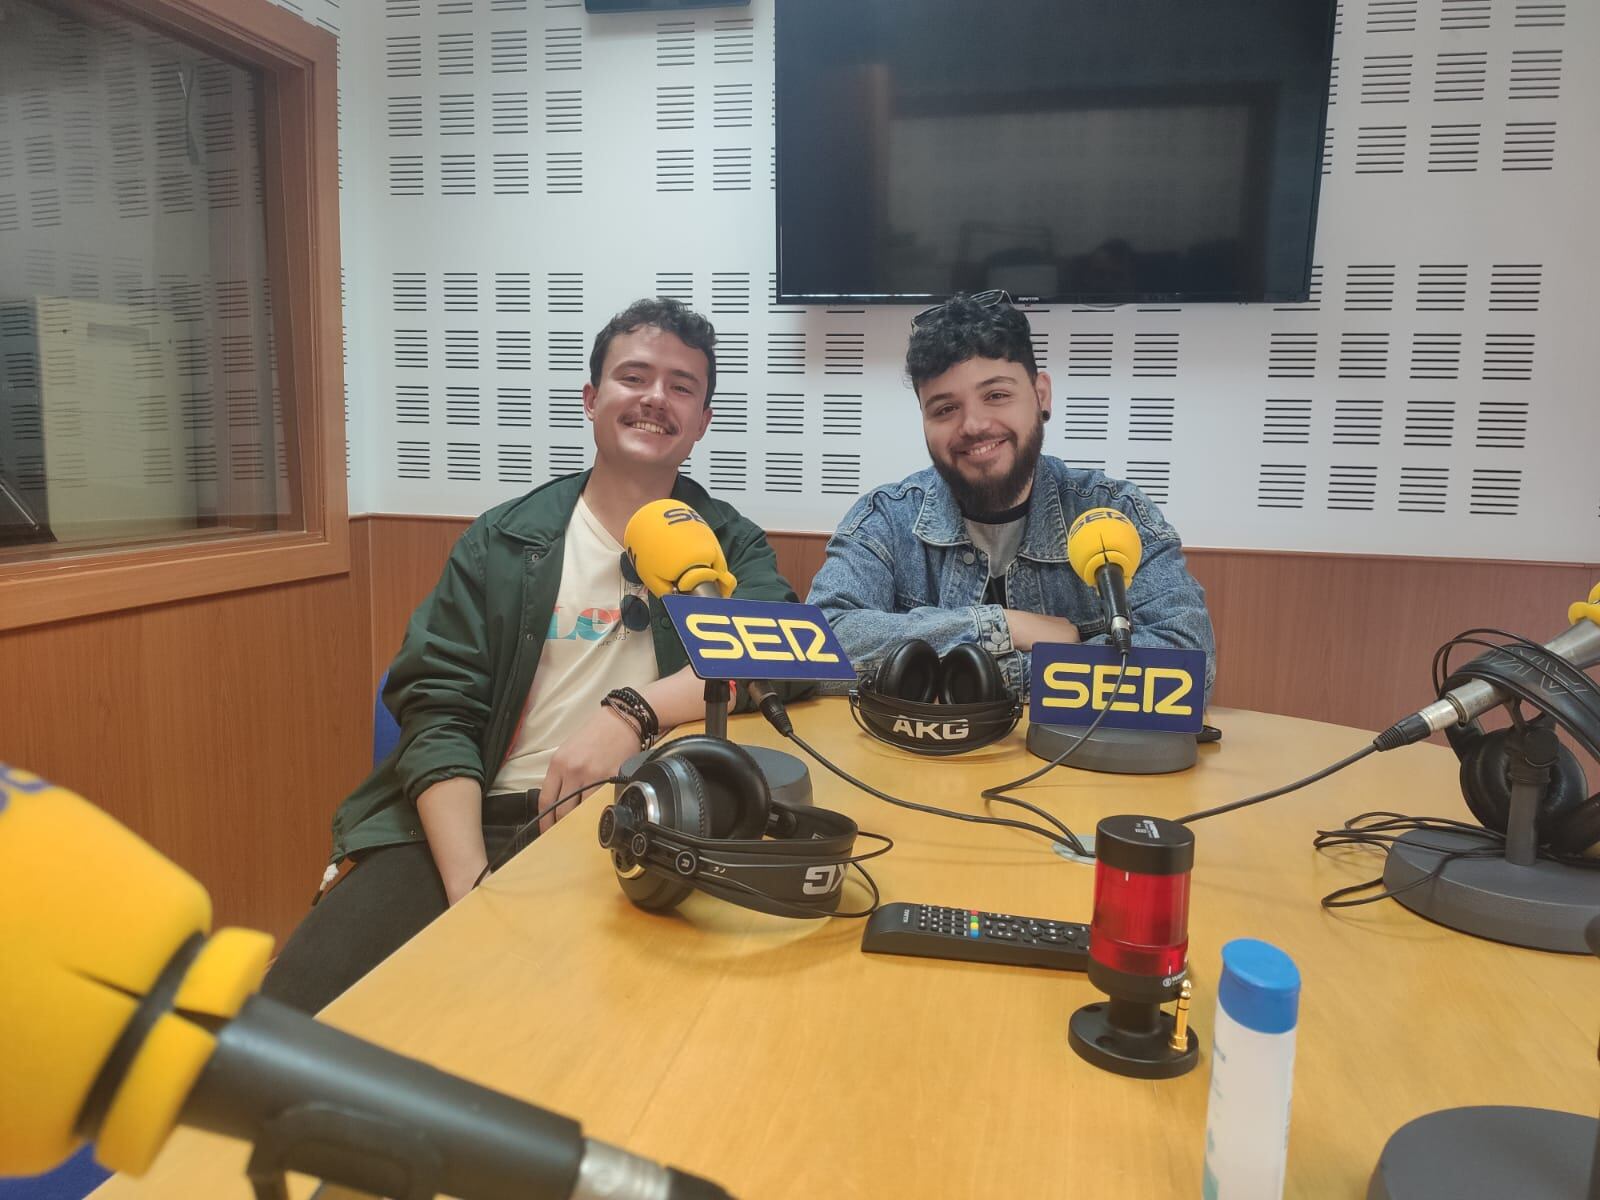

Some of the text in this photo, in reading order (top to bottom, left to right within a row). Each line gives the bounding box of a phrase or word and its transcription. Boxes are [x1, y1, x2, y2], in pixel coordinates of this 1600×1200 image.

[663, 508, 707, 526] SE
[685, 613, 839, 663] SER
[1041, 662, 1193, 716] SER
[892, 714, 970, 740] AKG
